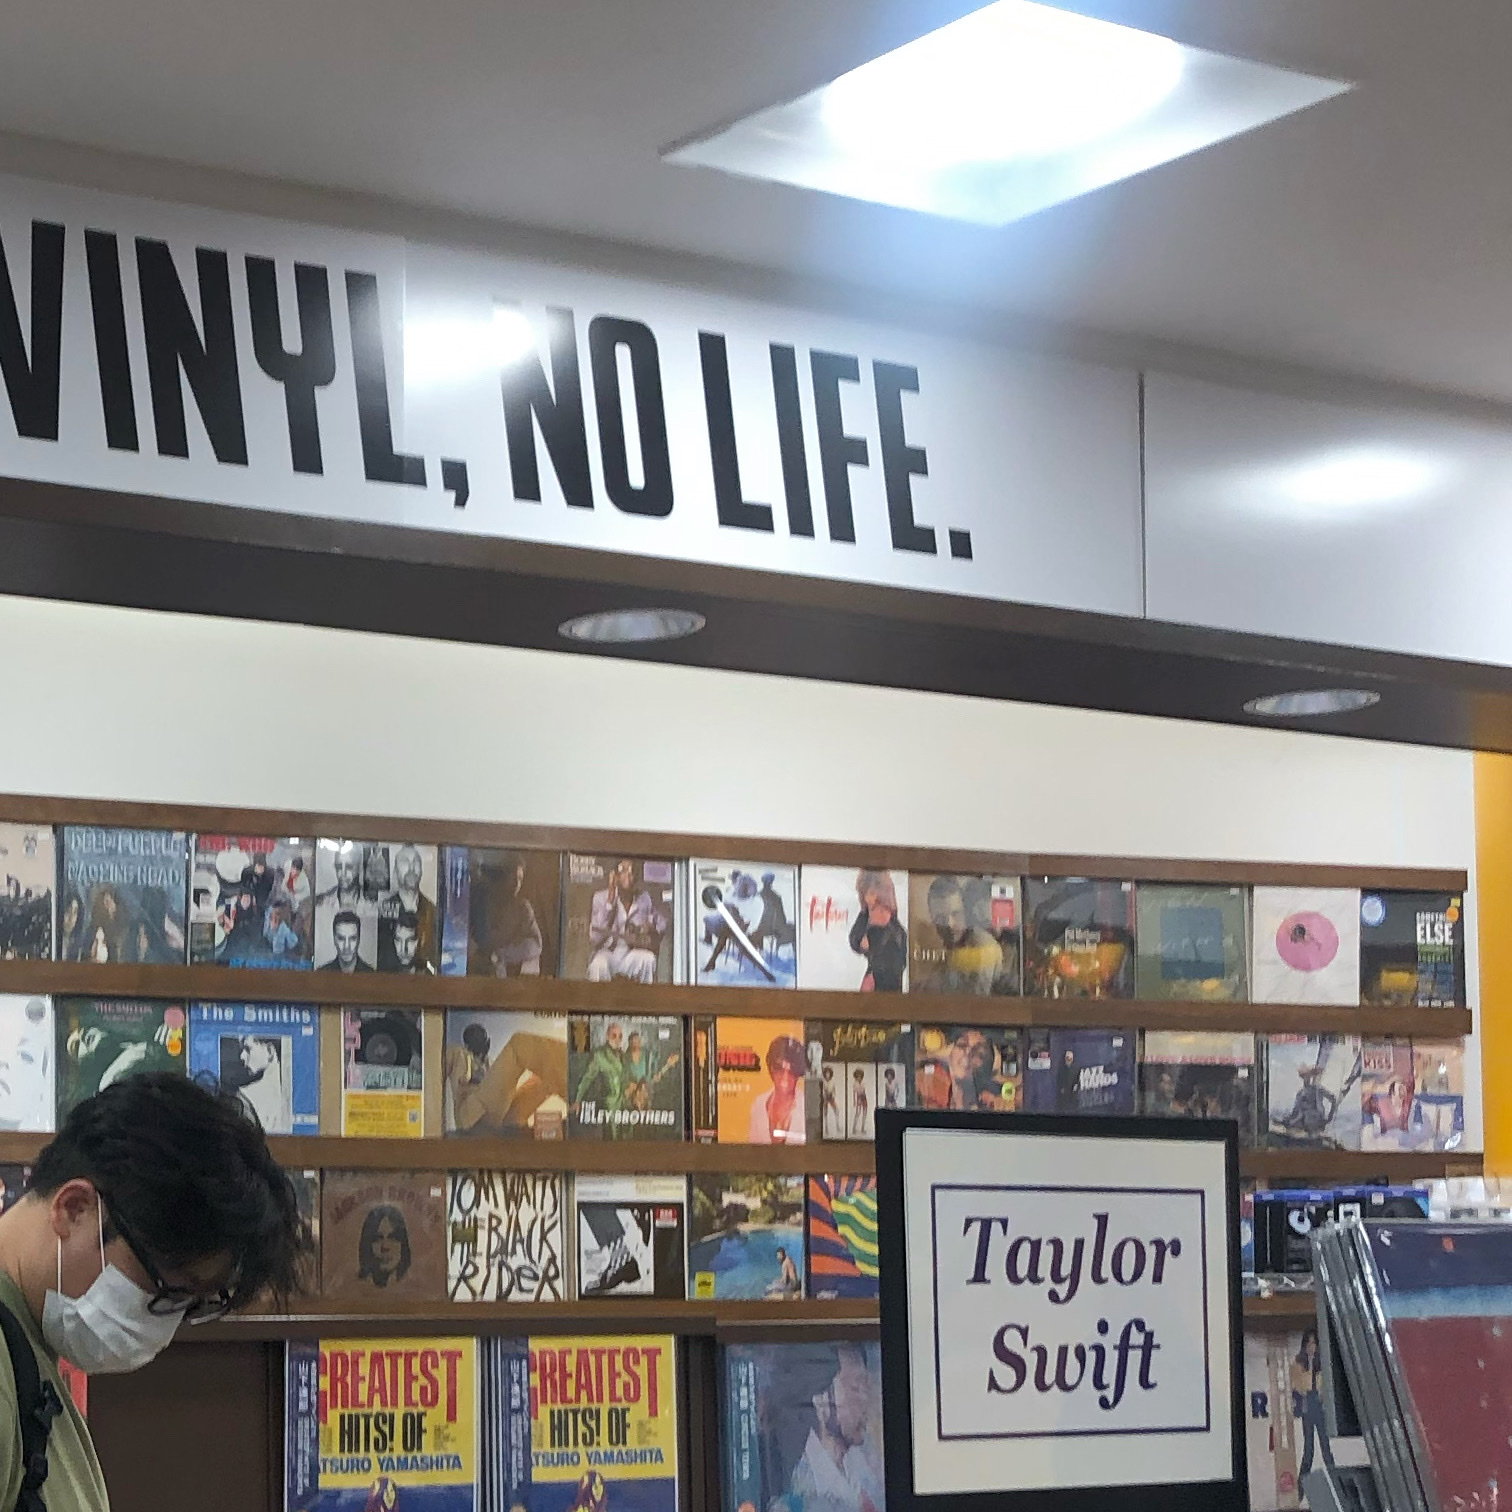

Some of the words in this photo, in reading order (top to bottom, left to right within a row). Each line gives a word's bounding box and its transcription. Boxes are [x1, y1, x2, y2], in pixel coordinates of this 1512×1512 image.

[493, 298, 674, 516] NO
[698, 331, 974, 561] LIFE.
[1416, 922, 1454, 946] ELSE
[199, 1003, 234, 1021] The
[245, 1005, 311, 1024] Smiths
[962, 1211, 1182, 1304] Taylor
[987, 1317, 1160, 1411] Swift
[339, 1412, 395, 1454] HITS!
[403, 1411, 428, 1454] OF
[550, 1407, 601, 1448] HITS!
[608, 1407, 631, 1446] OF
[377, 1453, 463, 1473] YAMASHITA
[586, 1448, 664, 1466] YAMASHITA
